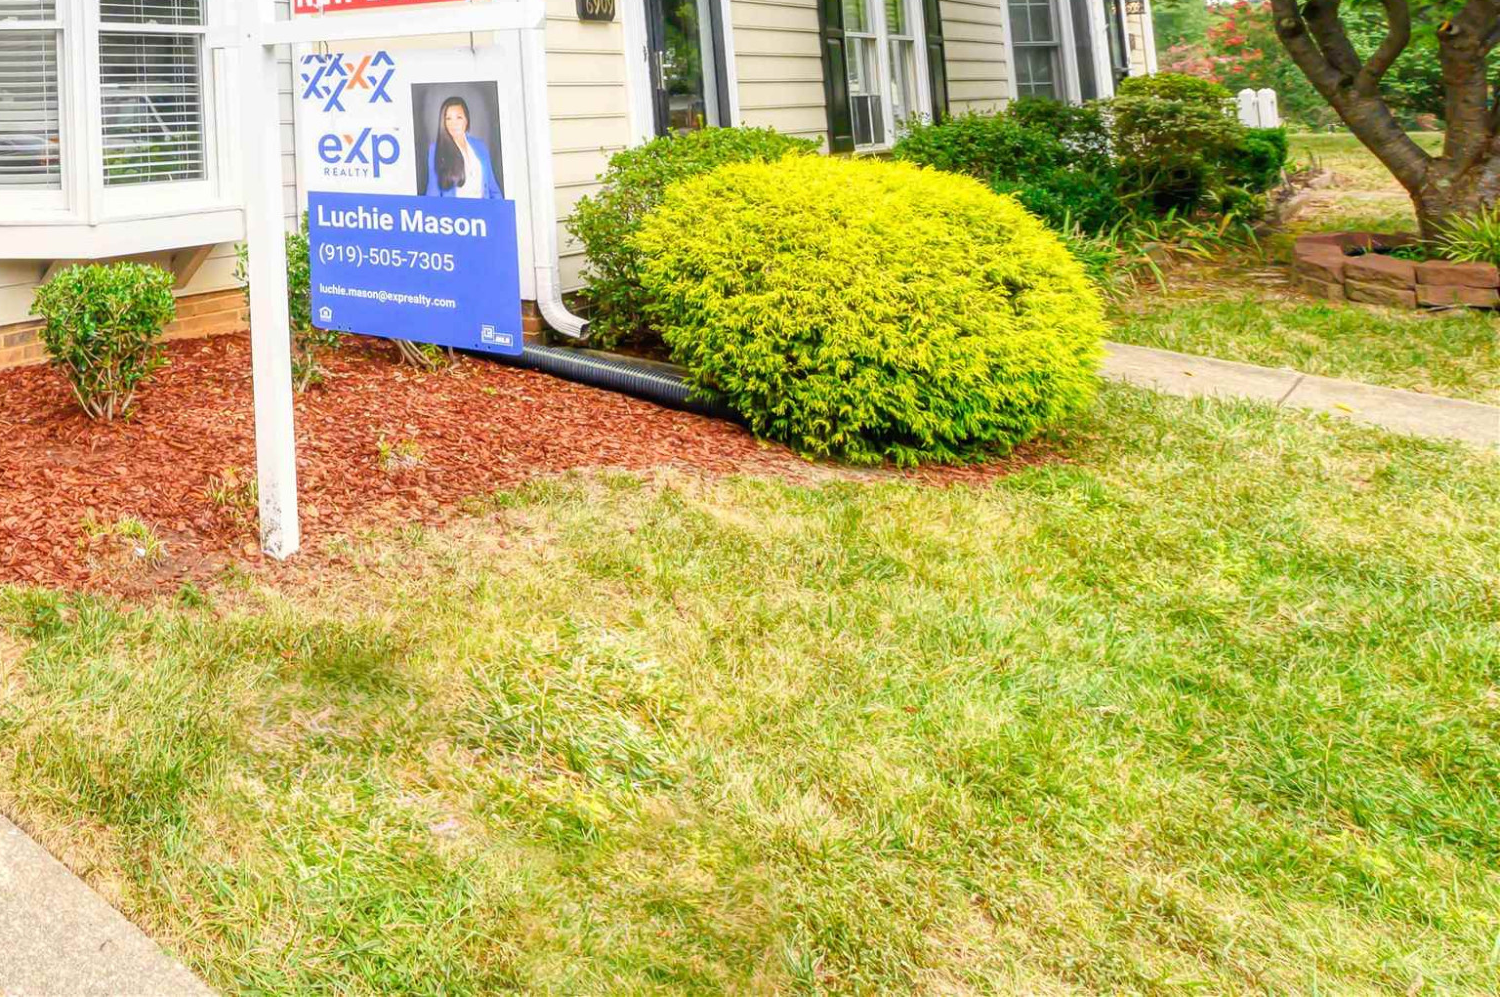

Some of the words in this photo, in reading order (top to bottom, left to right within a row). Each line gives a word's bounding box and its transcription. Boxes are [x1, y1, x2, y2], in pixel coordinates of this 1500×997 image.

[323, 167, 369, 177] REALTY
[317, 204, 394, 231] Luchie
[400, 208, 487, 237] Mason
[318, 242, 455, 272] (919)-505-7305
[319, 283, 456, 308] luchie.mason@exprealty.com
